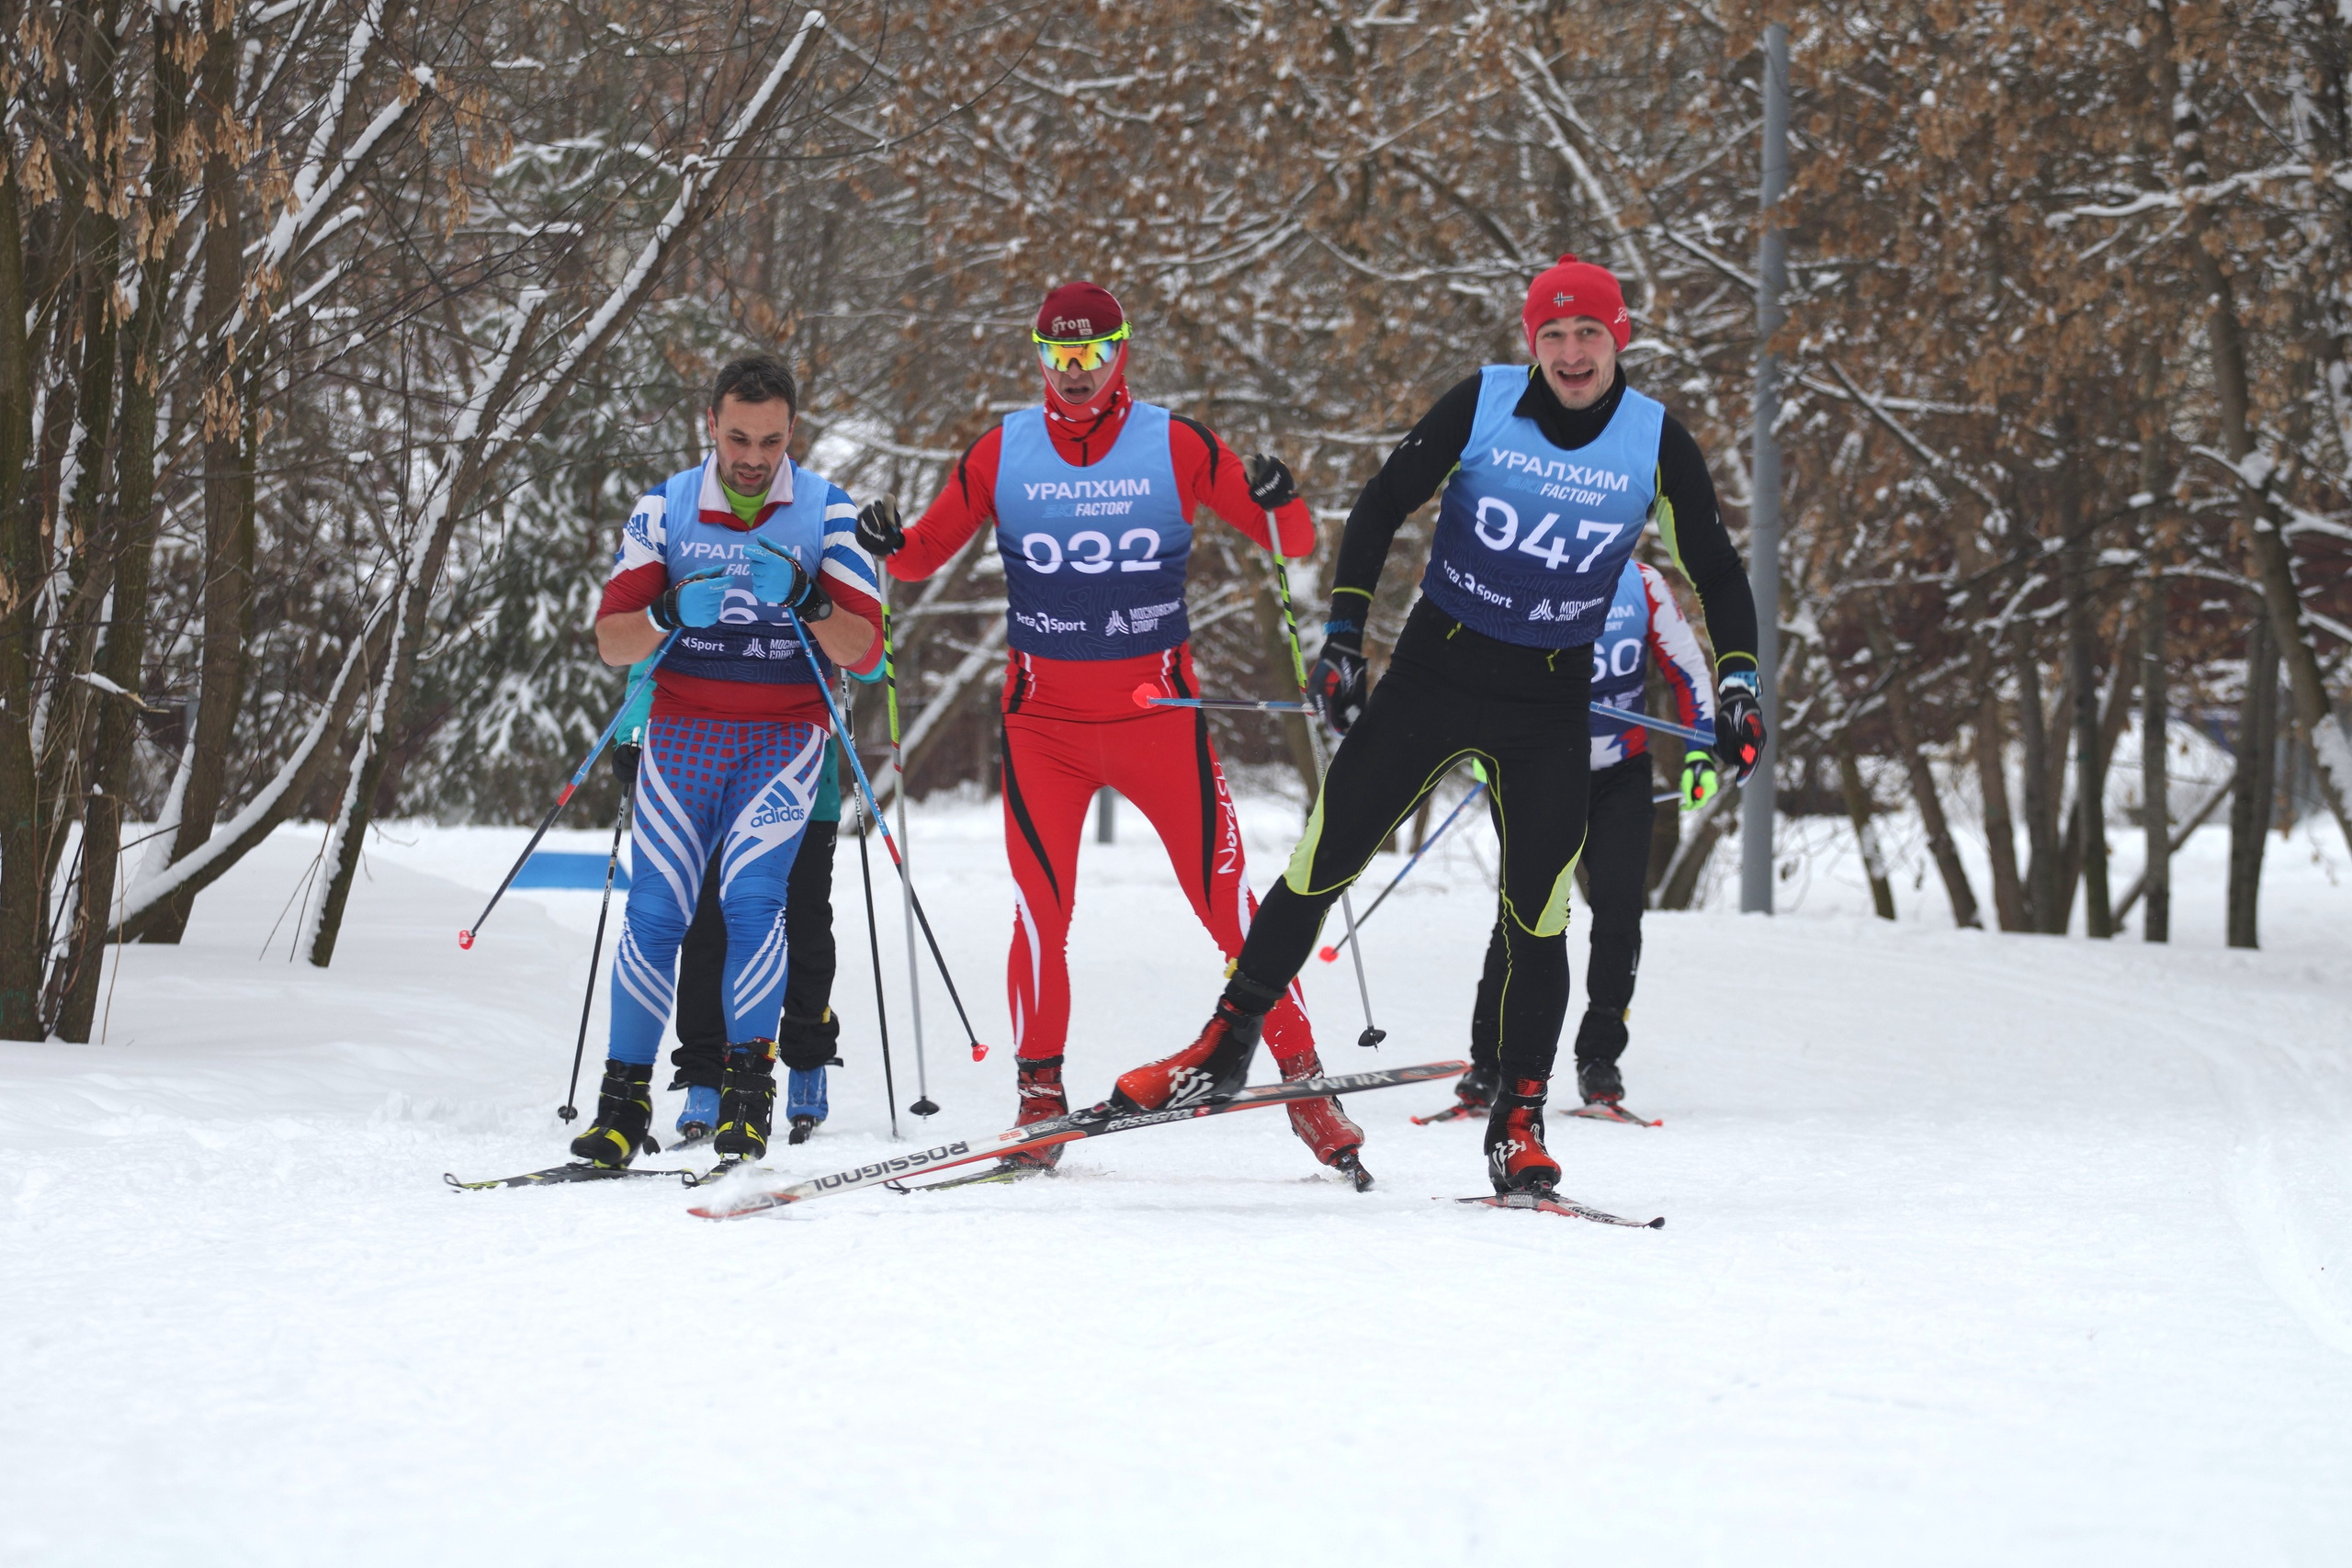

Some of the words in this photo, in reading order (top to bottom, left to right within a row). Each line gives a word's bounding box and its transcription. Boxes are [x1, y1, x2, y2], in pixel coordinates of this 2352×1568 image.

[1491, 447, 1630, 492] УРАЛХИМ
[1023, 479, 1151, 501] УРАЛХИМ
[1540, 483, 1607, 506] FACTORY
[1075, 502, 1133, 517] FACTORY
[1475, 496, 1625, 573] 947
[680, 541, 801, 560] УРАЛМ
[1022, 528, 1161, 574] 932
[1051, 618, 1087, 633] Sport
[1131, 618, 1159, 634] СПОРТ
[690, 637, 725, 651] Sport
[750, 807, 805, 828] adidas
[1103, 1108, 1195, 1132] ROSSIGNOL
[808, 1141, 970, 1191] ROSSIGNOL
